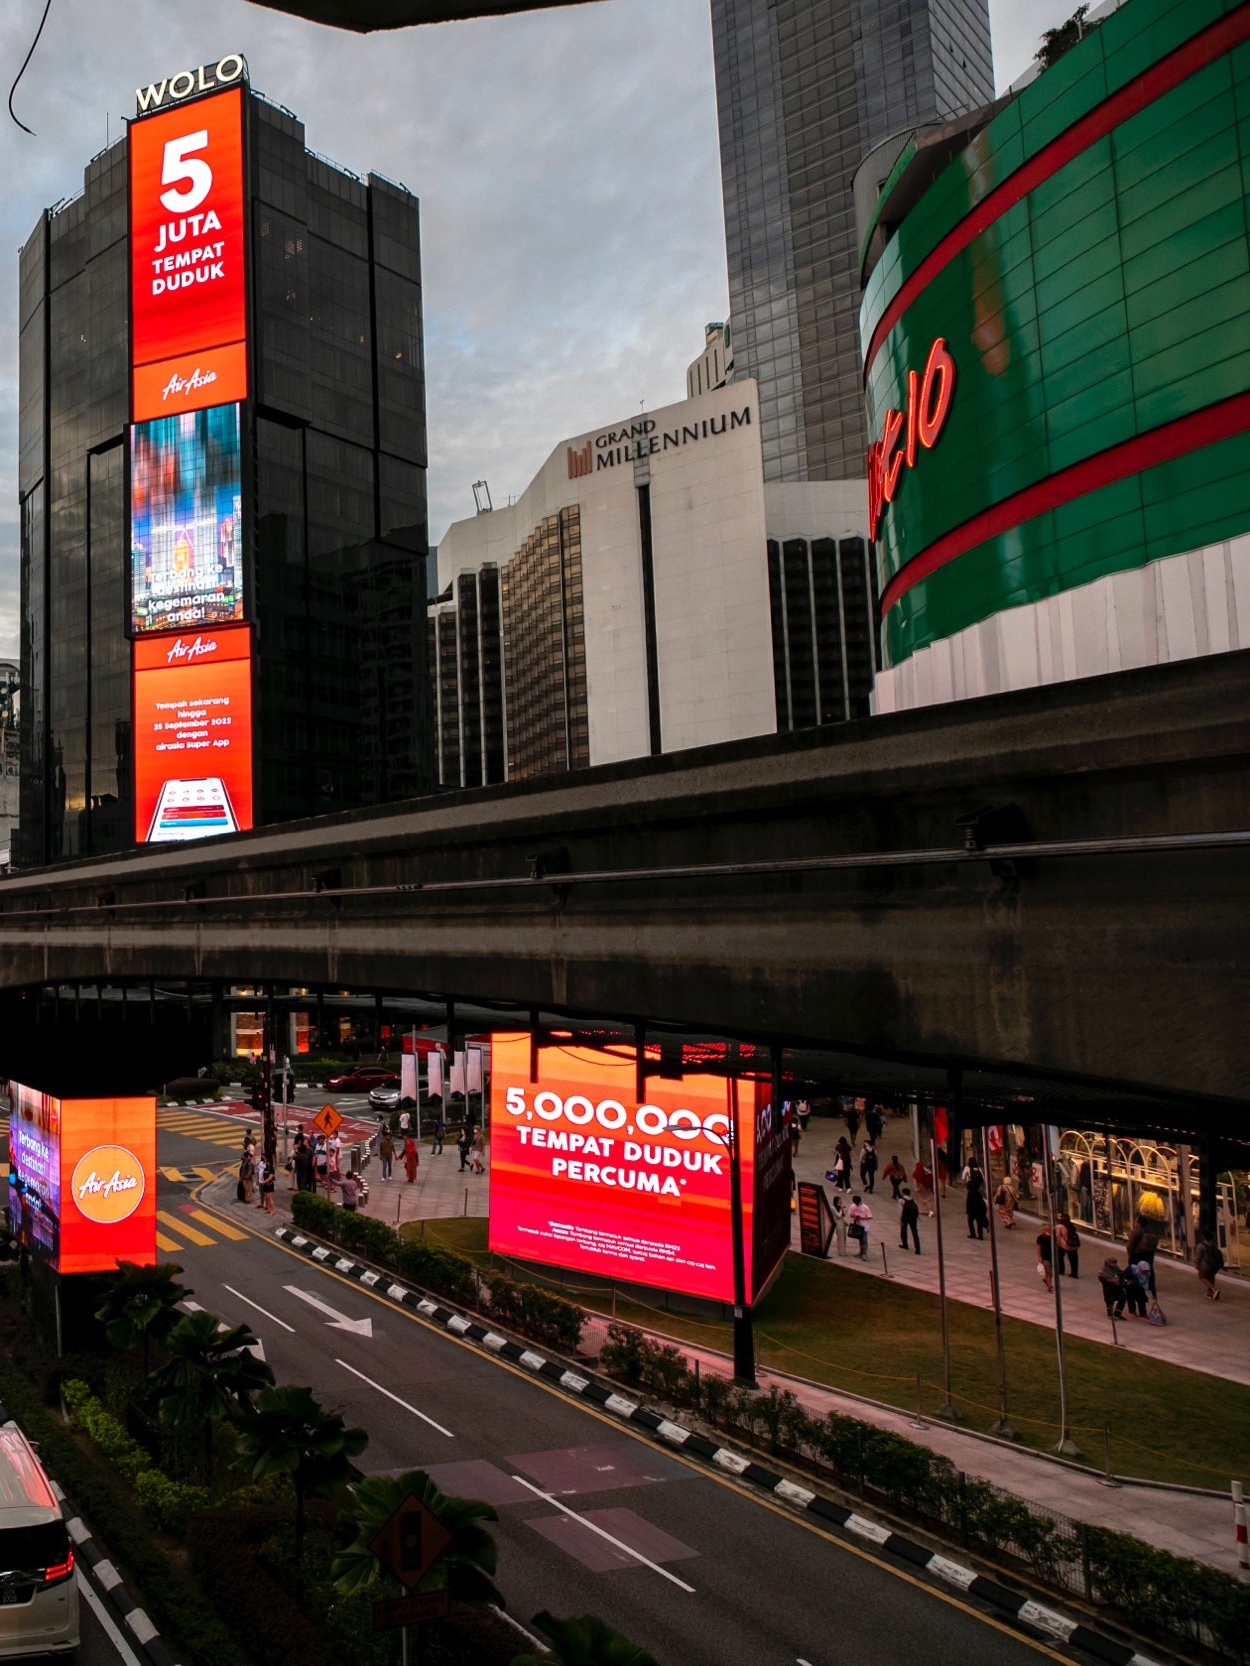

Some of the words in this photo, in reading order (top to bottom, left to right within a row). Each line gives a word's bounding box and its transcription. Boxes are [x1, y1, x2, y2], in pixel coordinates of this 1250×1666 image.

[136, 54, 243, 111] WOLO
[159, 129, 213, 213] 5
[153, 210, 222, 252] JUTA
[152, 241, 225, 274] TEMPAT
[152, 261, 225, 295] DUDUK
[595, 419, 656, 449] GRAND
[596, 406, 751, 471] MILLENNIUM
[148, 592, 225, 611] kegemaran
[167, 607, 205, 622] anda!
[156, 701, 188, 710] Tempah
[189, 697, 229, 706] sekarang
[178, 710, 207, 719] hingga
[165, 719, 209, 730] September
[211, 717, 232, 726] 2022
[176, 731, 208, 739] dengan
[186, 740, 211, 749] Super
[213, 739, 230, 747] App
[505, 1087, 734, 1145] 5,000,000
[516, 1125, 614, 1158] TEMPAT
[624, 1141, 723, 1175] DUDUK
